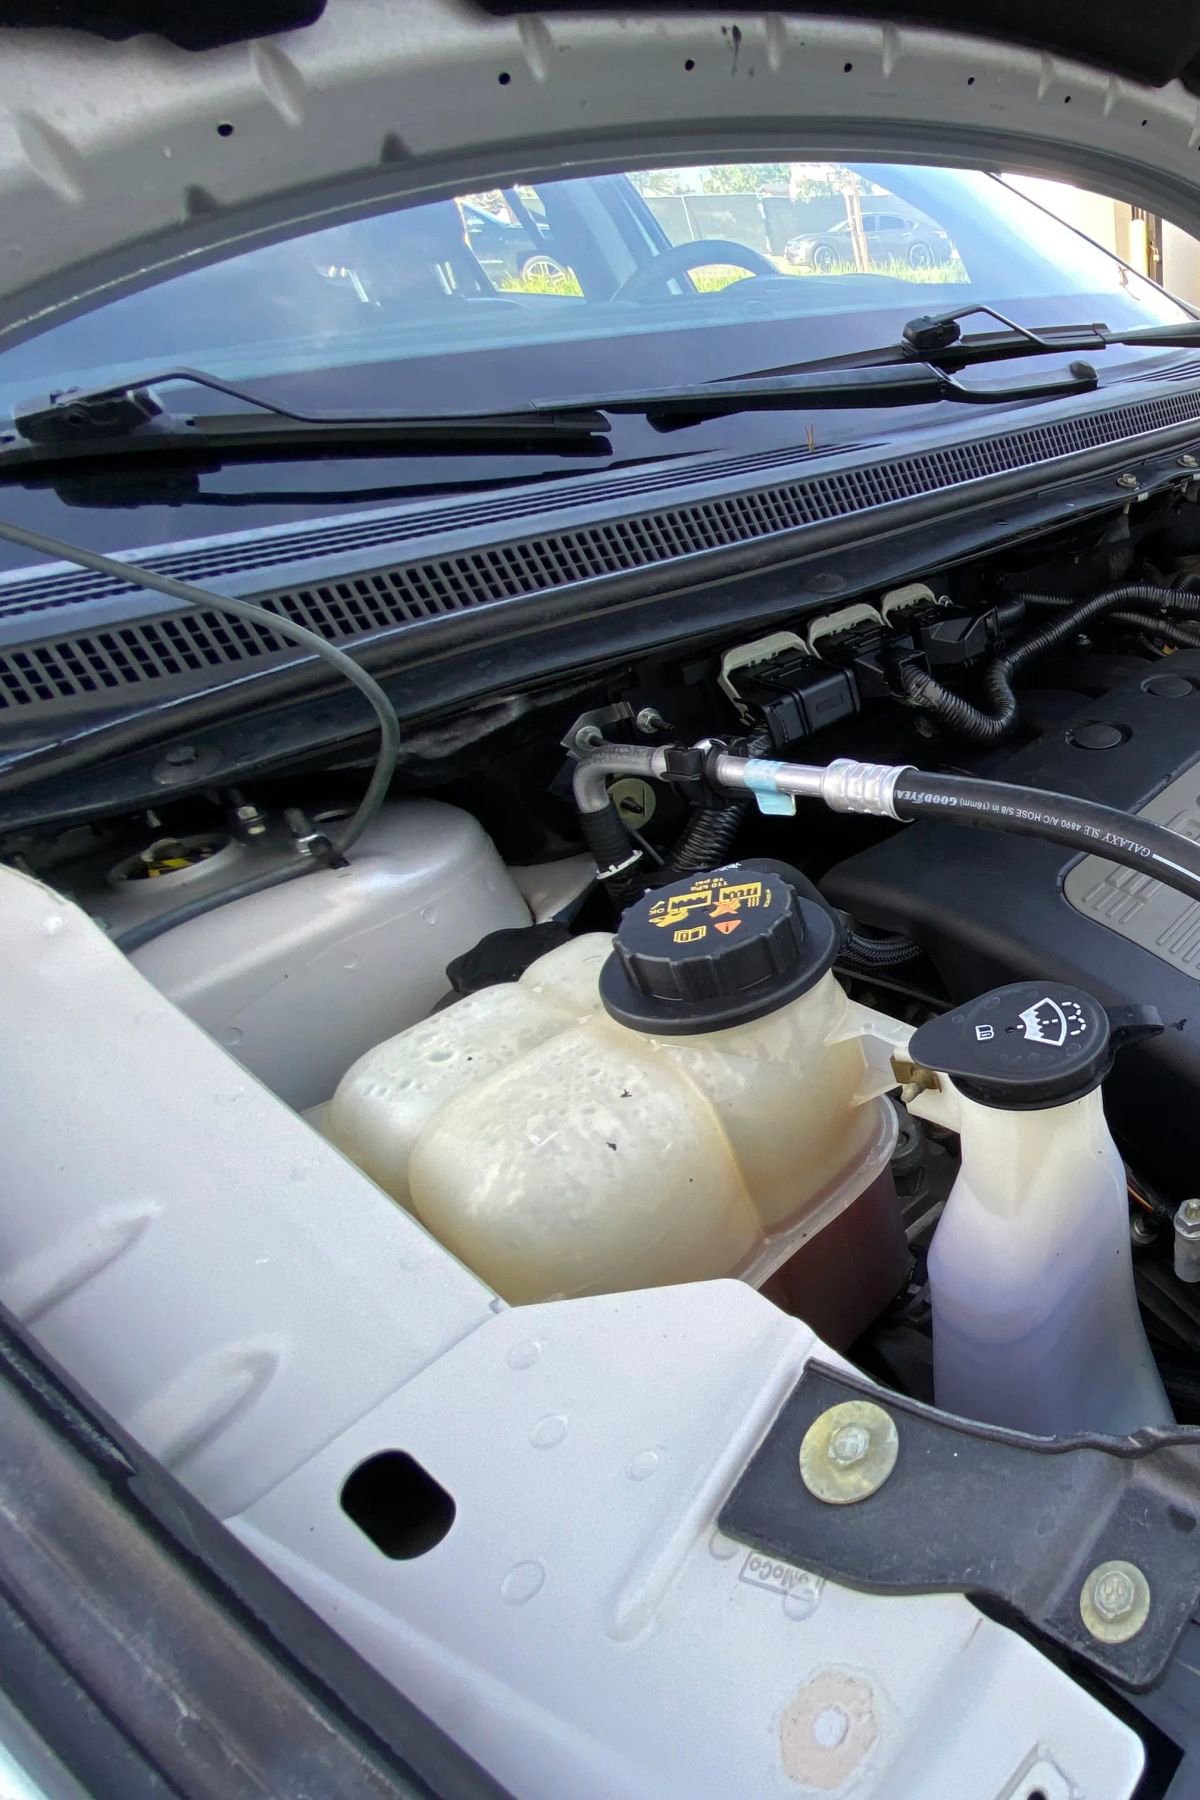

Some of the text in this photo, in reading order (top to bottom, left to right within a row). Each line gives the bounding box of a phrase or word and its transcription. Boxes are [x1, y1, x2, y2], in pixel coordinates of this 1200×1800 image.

[895, 790, 958, 806] GOODYEA
[1001, 805, 1015, 816] 5/8
[1016, 808, 1041, 820] HOSE
[1043, 815, 1059, 826] A/C
[1061, 819, 1082, 832] 4890
[1084, 825, 1101, 838] SLE
[1101, 832, 1151, 857] GALAXY
